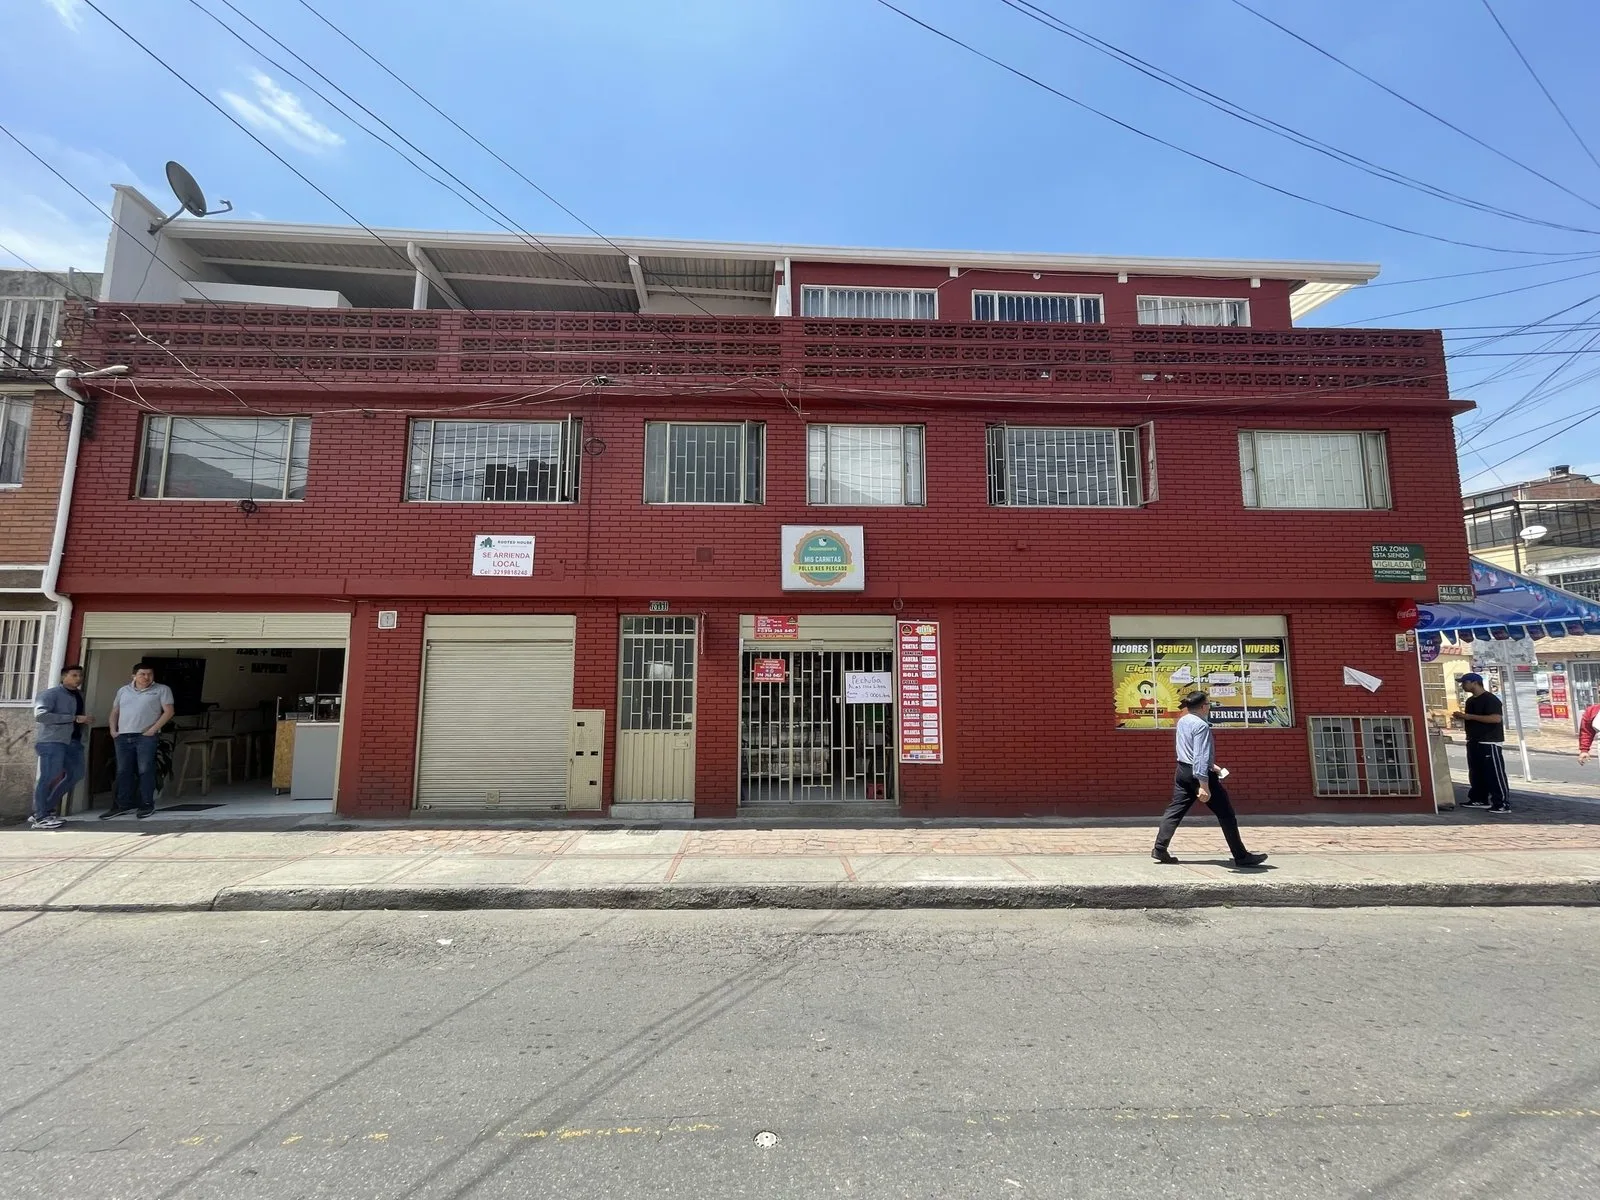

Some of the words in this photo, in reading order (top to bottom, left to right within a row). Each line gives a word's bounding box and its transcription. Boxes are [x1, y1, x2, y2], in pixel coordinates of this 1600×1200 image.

[1112, 645, 1148, 654] LICORES
[1156, 645, 1193, 654] CERVEZA
[1201, 645, 1238, 654] LACTEOS
[1245, 644, 1280, 653] VIVERES
